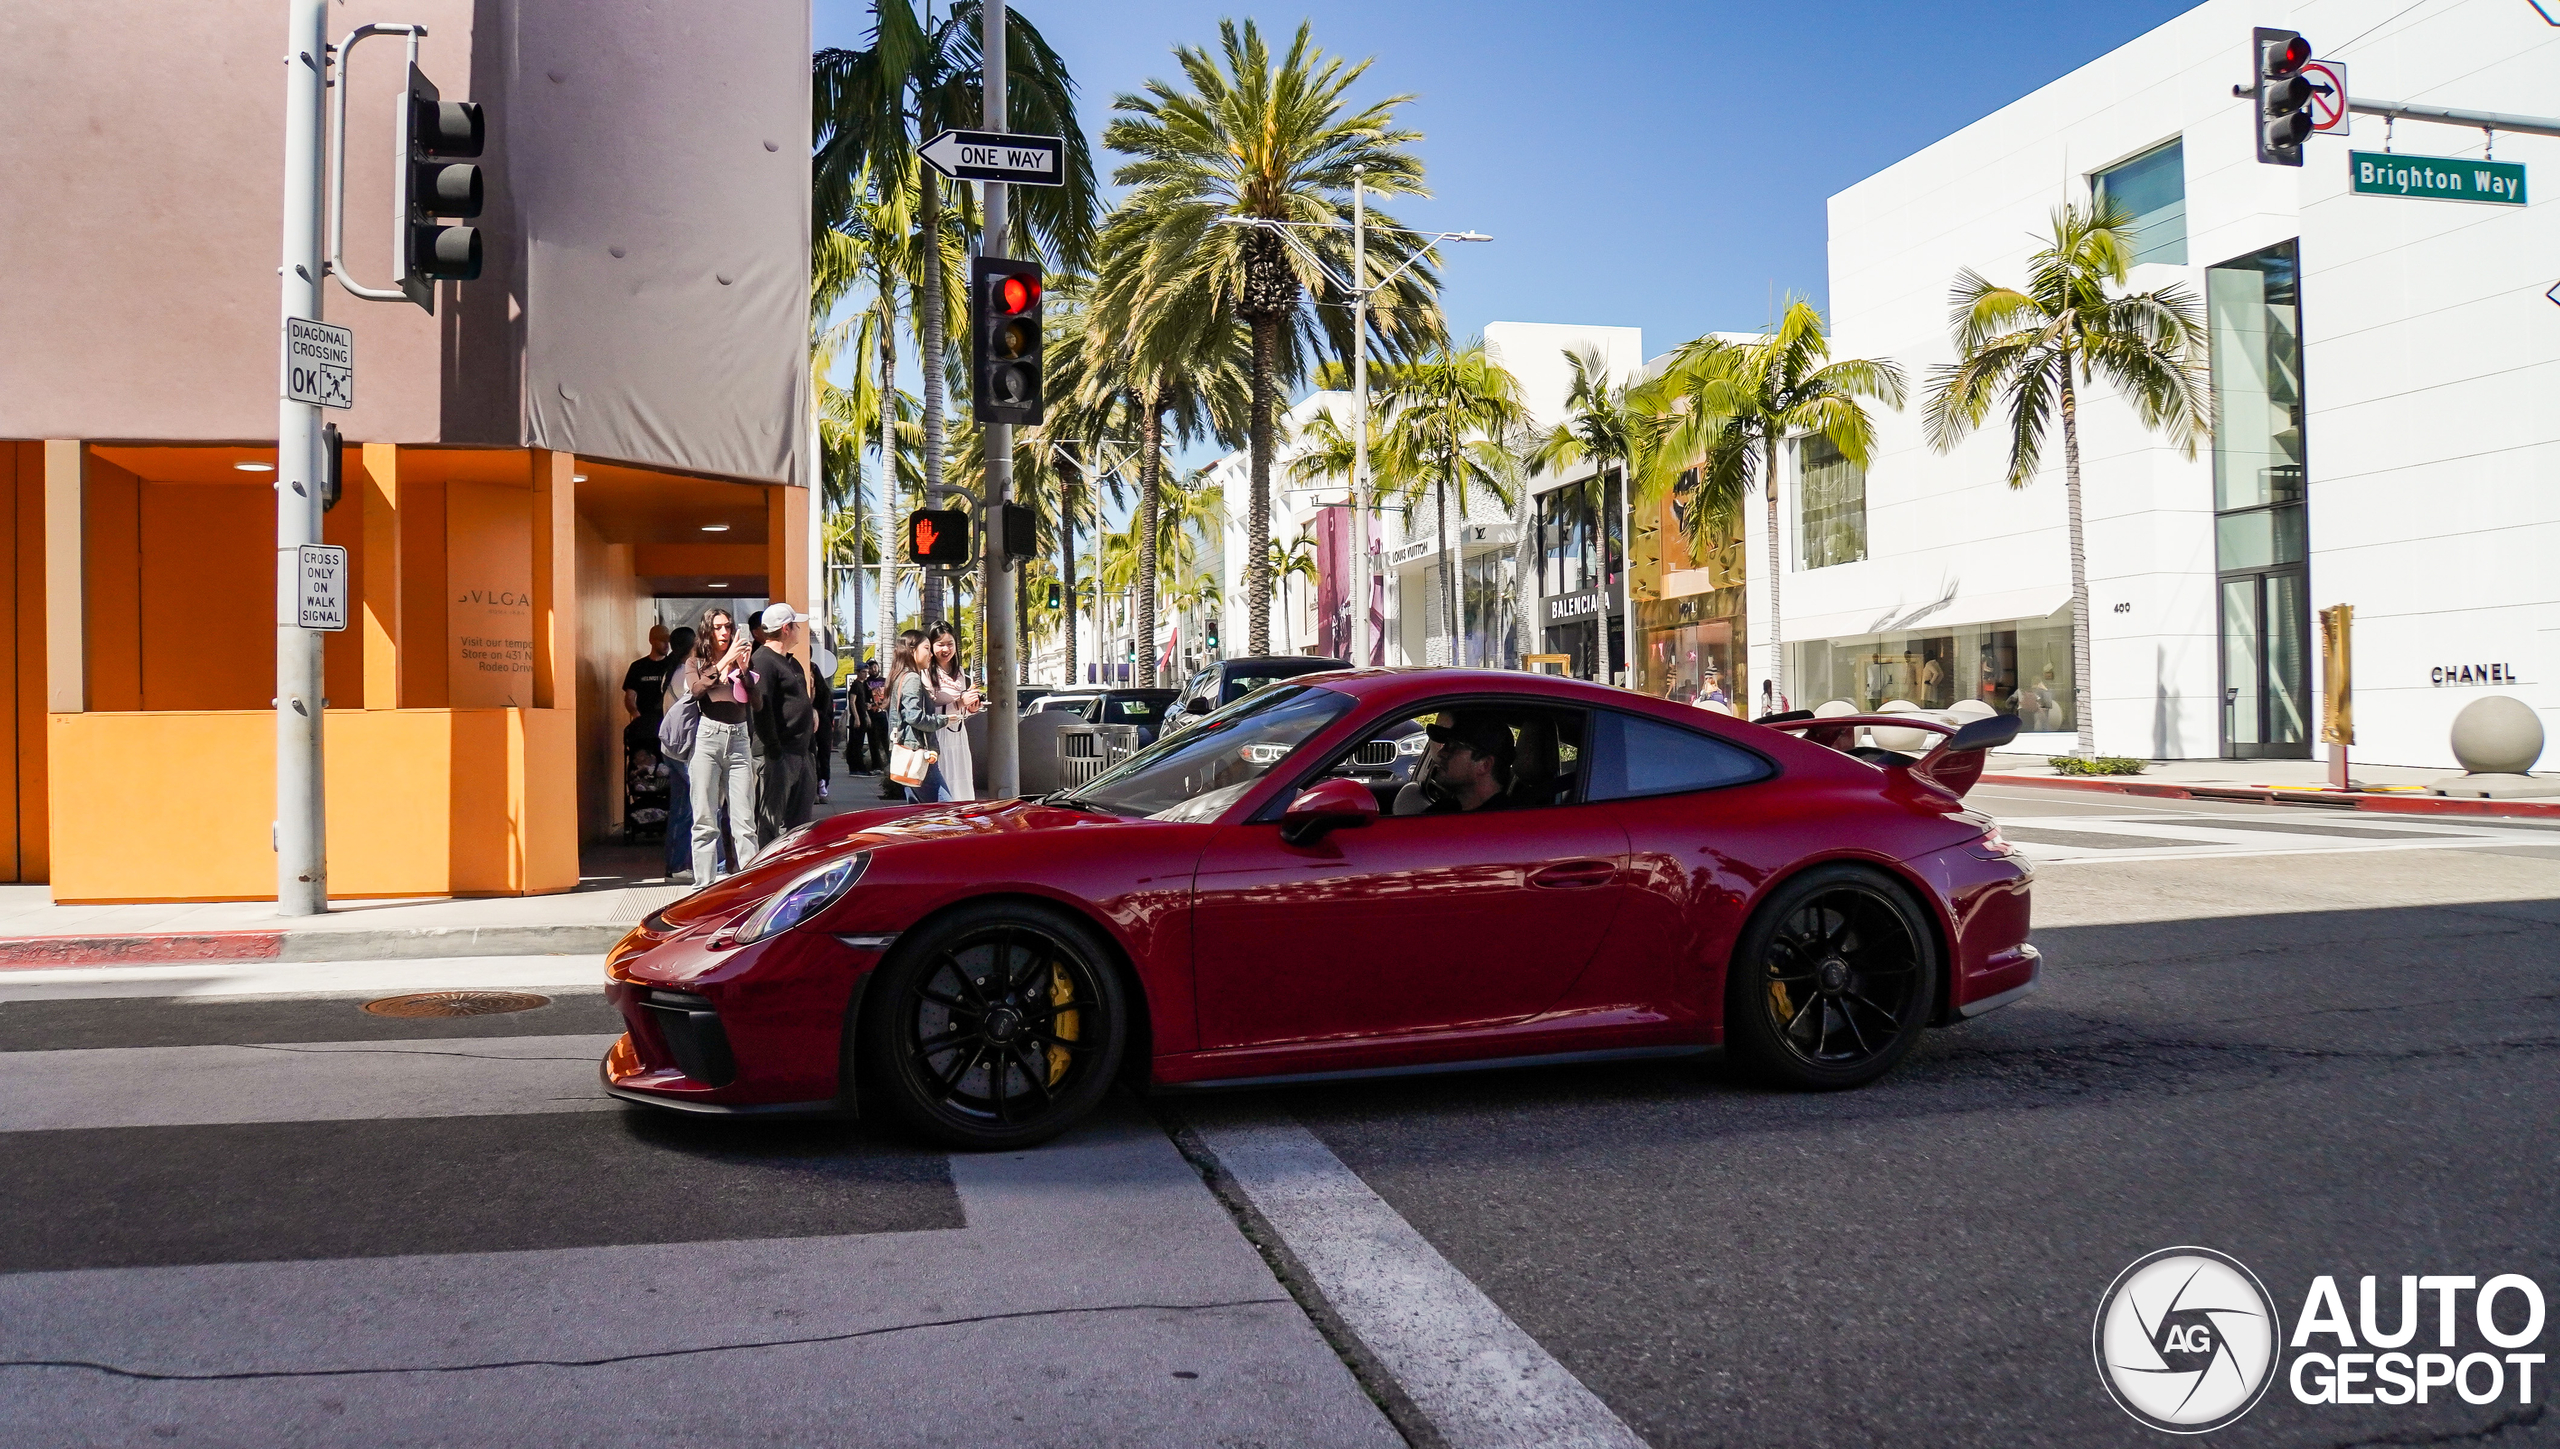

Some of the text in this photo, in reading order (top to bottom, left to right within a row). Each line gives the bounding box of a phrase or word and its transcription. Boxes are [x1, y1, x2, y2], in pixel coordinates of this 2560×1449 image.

[961, 146, 1044, 169] ONE WAY
[2360, 161, 2518, 200] Brighton Way
[292, 324, 348, 347] DIAGONAL
[293, 341, 348, 363] CROSSING
[292, 367, 317, 395] OK
[304, 552, 340, 566] CROSS
[1392, 541, 1429, 563] LOUIS VUITTON
[307, 567, 335, 579] ONLY
[313, 582, 328, 594] ON
[307, 596, 336, 608] WALK
[1552, 591, 1611, 619] BALENCIAA
[2113, 602, 2131, 613] 400
[302, 610, 341, 622] SIGNAL
[460, 636, 483, 647] Visit
[486, 639, 502, 648] our
[461, 648, 488, 659] Store
[490, 651, 503, 660] on
[505, 650, 522, 661] 431
[479, 661, 509, 672] Rodeo
[2431, 662, 2516, 684] CHANEL
